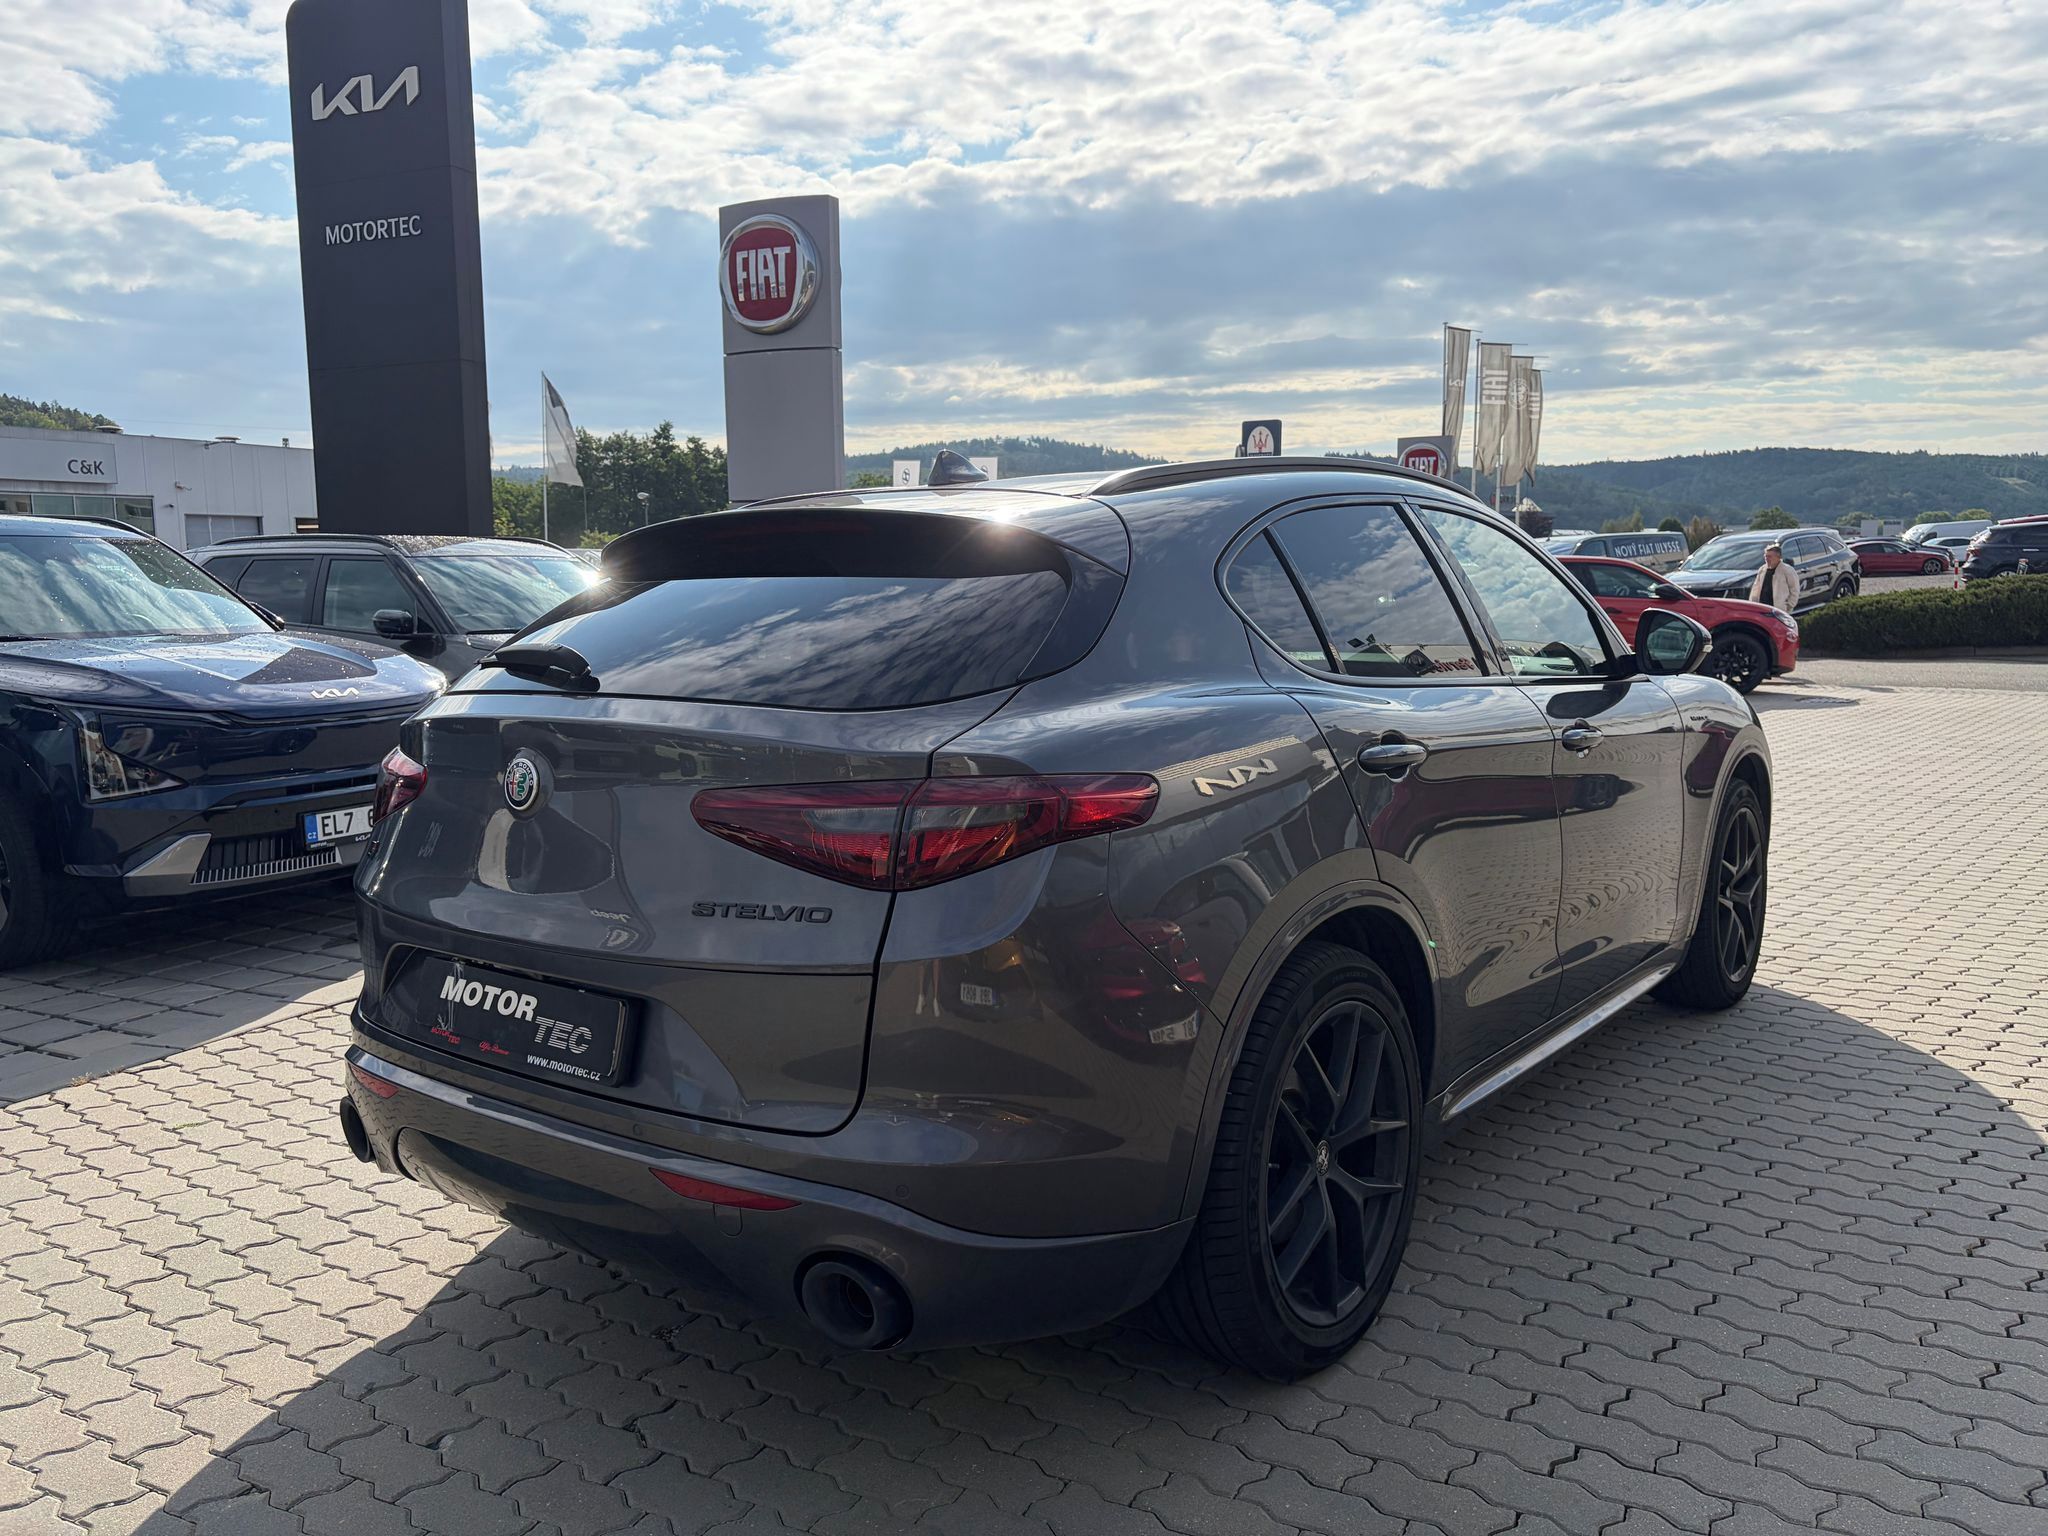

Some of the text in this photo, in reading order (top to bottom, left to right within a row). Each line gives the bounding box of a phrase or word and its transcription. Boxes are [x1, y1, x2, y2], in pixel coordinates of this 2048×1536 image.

[311, 65, 419, 121] KIA
[325, 215, 422, 246] MOTORTEC
[736, 246, 792, 302] FIAT
[1481, 366, 1509, 405] FIAT
[67, 459, 105, 476] C&K
[1615, 540, 1681, 558] NOVÝ FIAT ULYSSE
[310, 686, 360, 699] KIA
[307, 831, 317, 840] CZ
[321, 811, 354, 837] EL7
[690, 901, 833, 924] STELVIO
[439, 975, 538, 1022] MOTOR
[534, 1015, 593, 1055] TEC
[526, 1054, 601, 1082] www.motortec.cz
